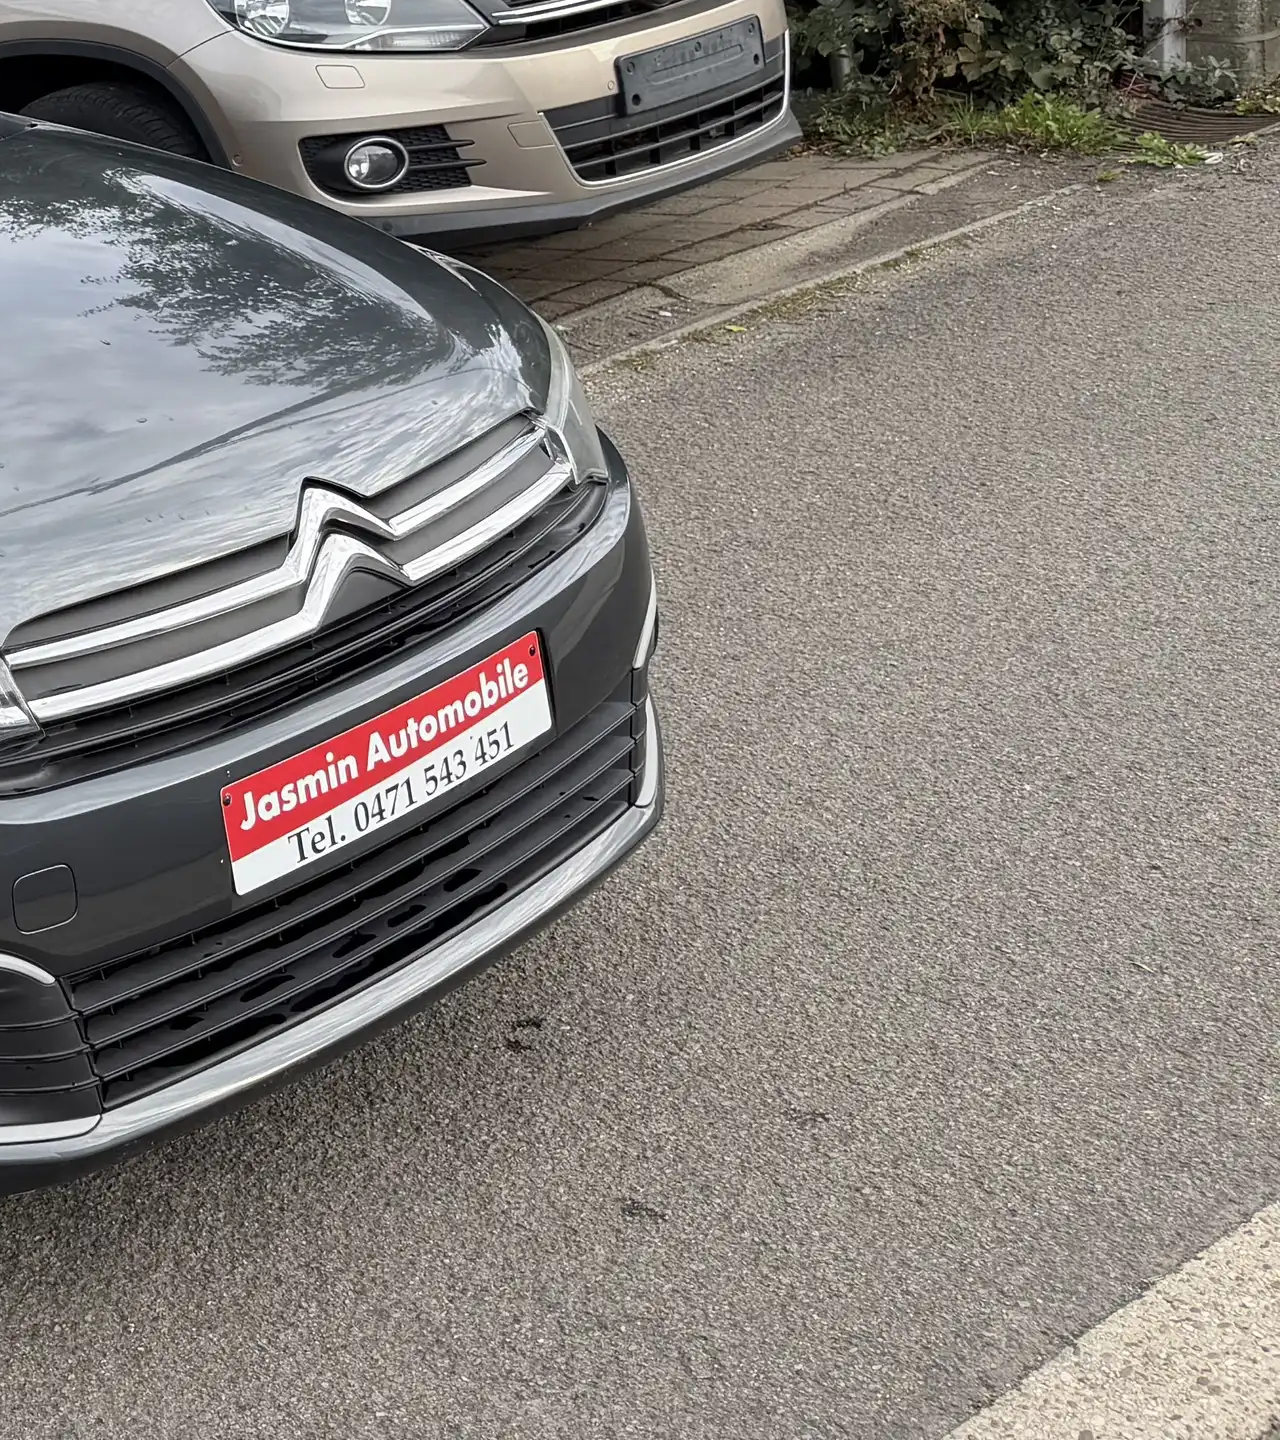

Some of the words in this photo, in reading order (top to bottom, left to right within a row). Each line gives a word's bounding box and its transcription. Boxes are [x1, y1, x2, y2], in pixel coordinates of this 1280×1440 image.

[240, 752, 358, 831] Jasmin
[366, 658, 529, 772] Automobile
[288, 816, 347, 864] Tel.
[354, 777, 418, 832] 0471
[424, 749, 467, 797] 543
[474, 720, 516, 768] 451
